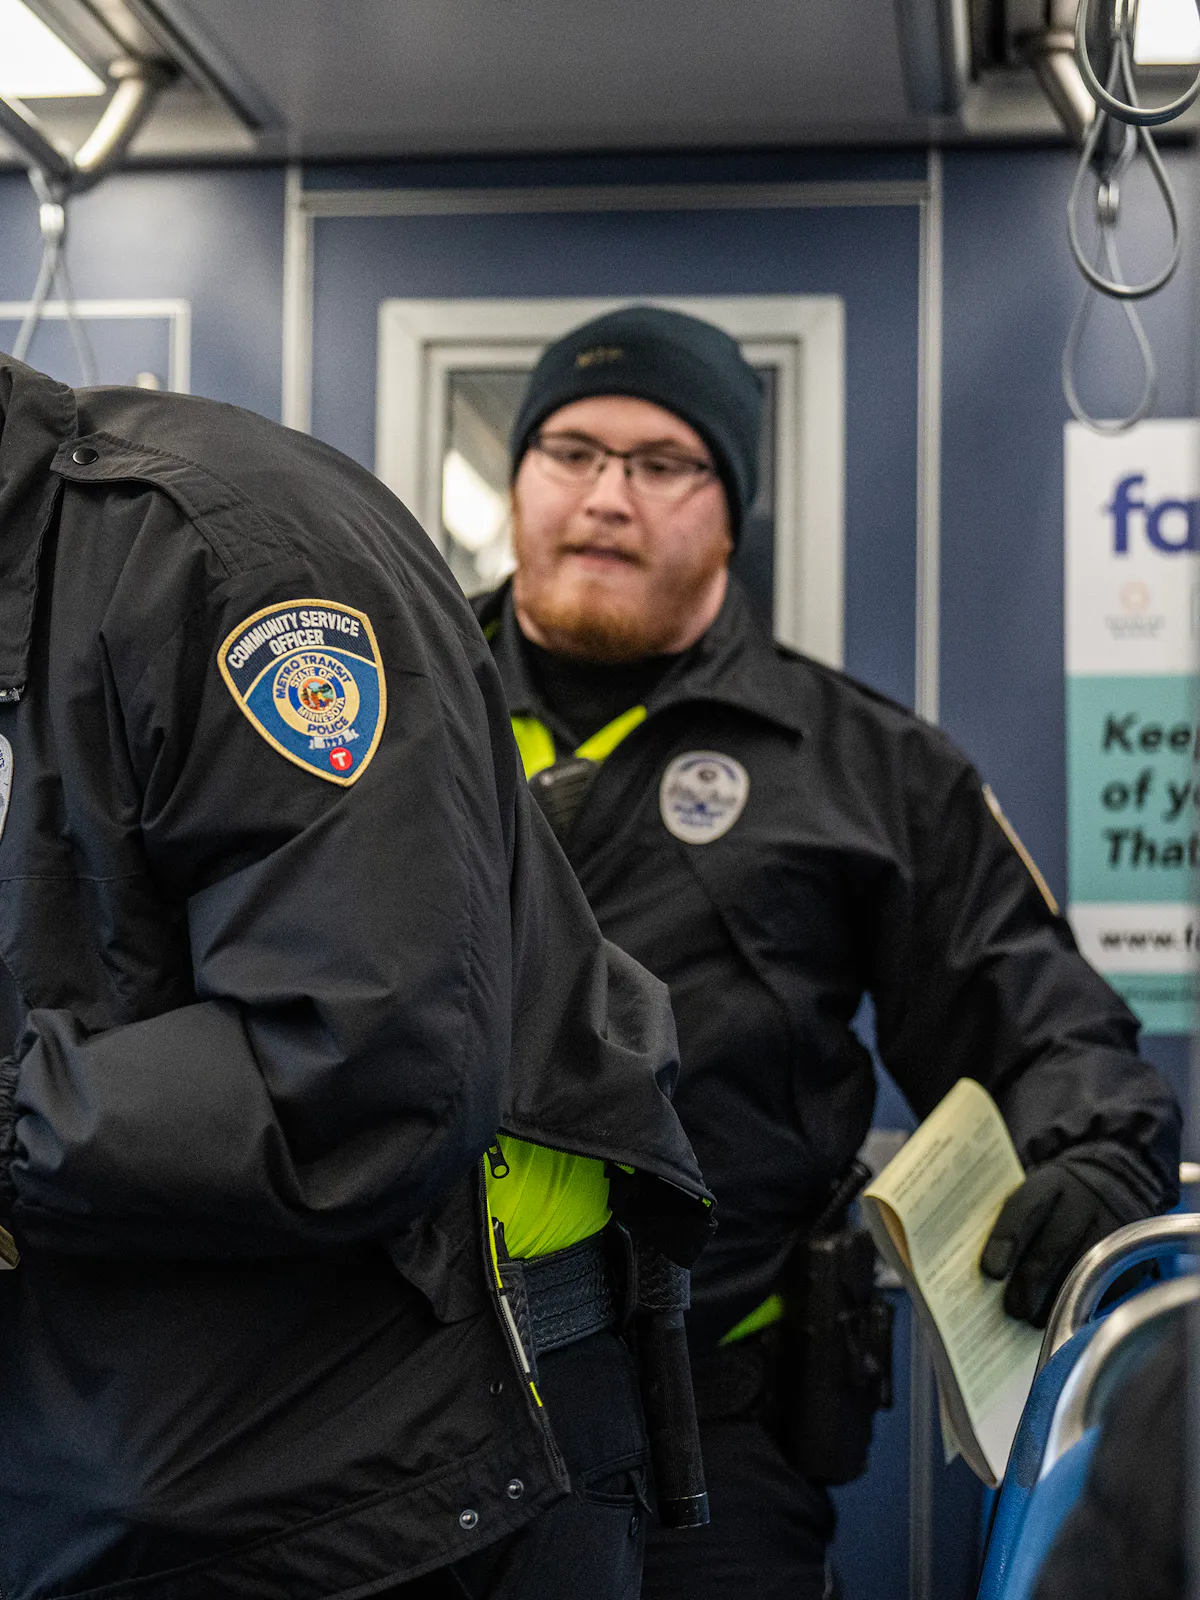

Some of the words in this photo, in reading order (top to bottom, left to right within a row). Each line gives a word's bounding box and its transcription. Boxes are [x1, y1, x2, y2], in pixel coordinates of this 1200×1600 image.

[227, 612, 299, 669] COMMUNITY
[299, 610, 360, 638] SERVICE
[268, 629, 325, 656] OFFICER
[275, 659, 300, 699] METRO
[301, 655, 352, 682] TRANSIT
[290, 667, 315, 689] STATE
[318, 668, 334, 680] OF
[297, 697, 346, 723] MINNESOTA
[307, 716, 349, 735] POLICE
[332, 752, 346, 767] T
